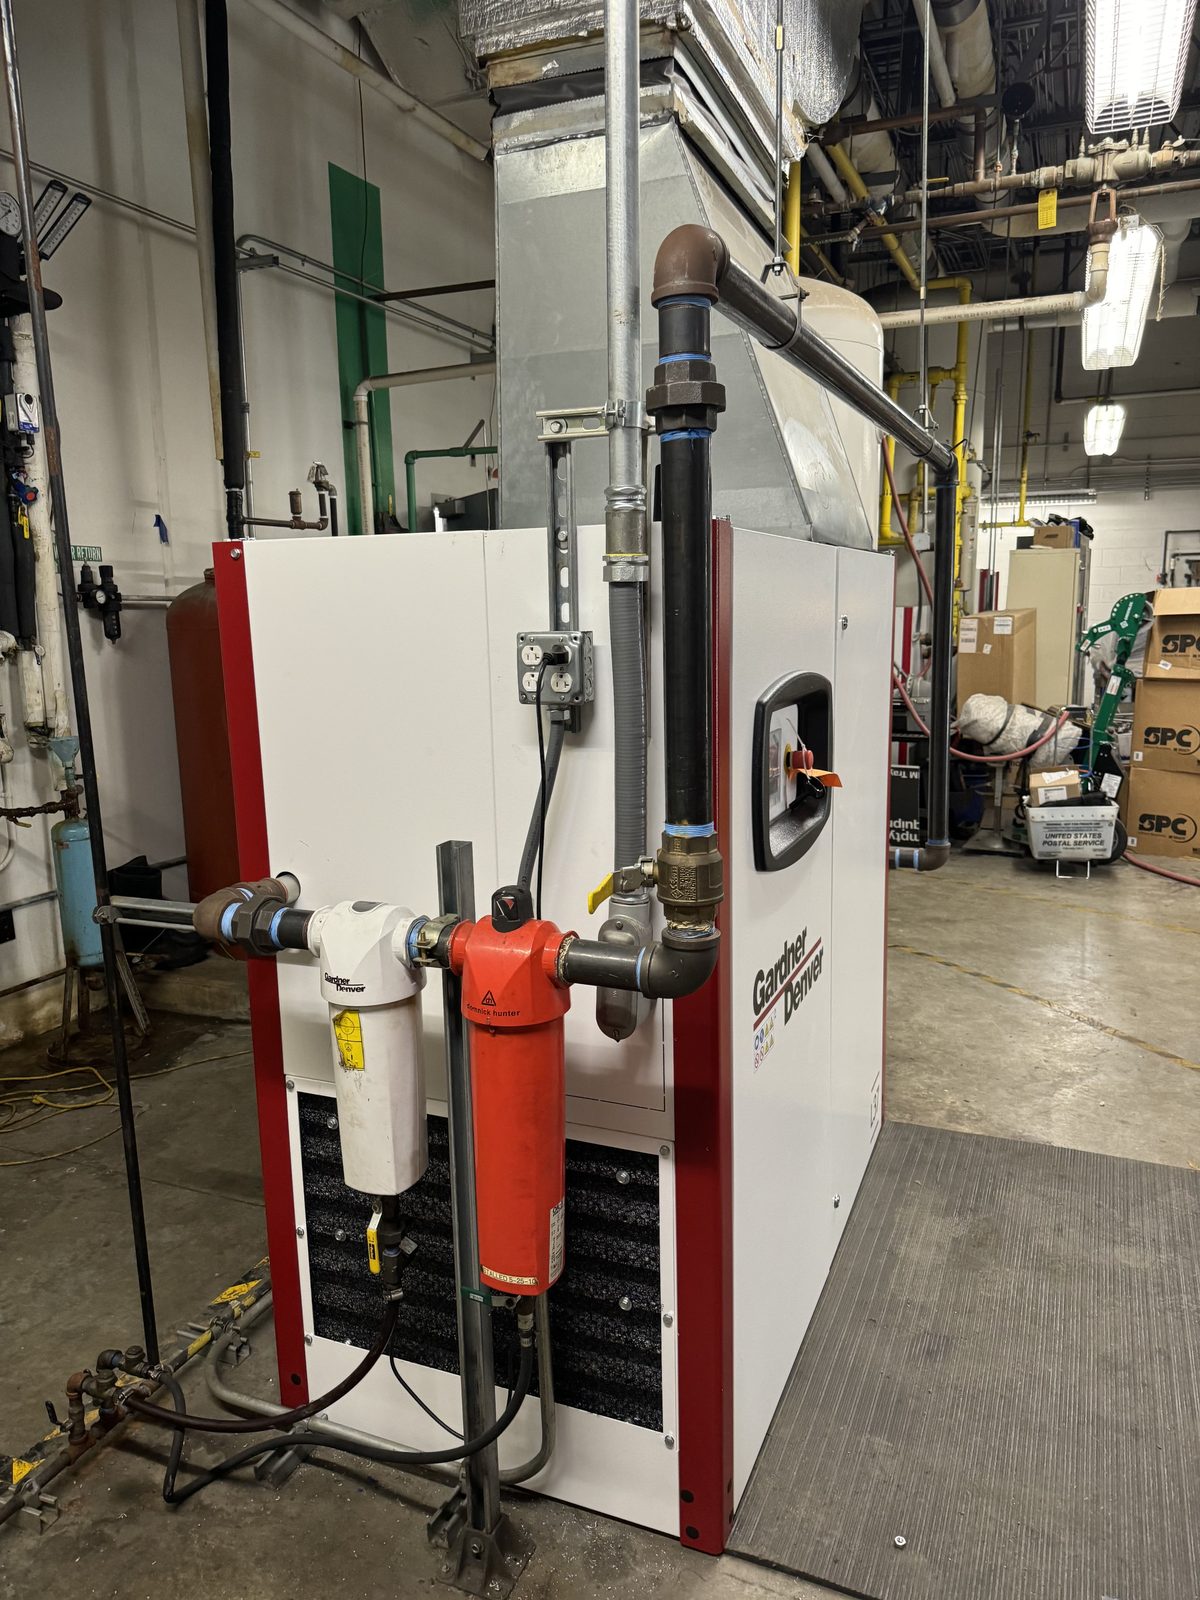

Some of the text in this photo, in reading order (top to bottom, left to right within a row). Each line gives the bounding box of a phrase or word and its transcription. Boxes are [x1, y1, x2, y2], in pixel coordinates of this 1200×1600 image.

[1162, 634, 1200, 653] SP
[1144, 726, 1193, 748] SPC
[1138, 813, 1187, 836] SPC
[324, 972, 350, 985] Gardner
[753, 926, 807, 1016] Gardner
[336, 984, 366, 992] Denver
[784, 945, 823, 1026] Denver
